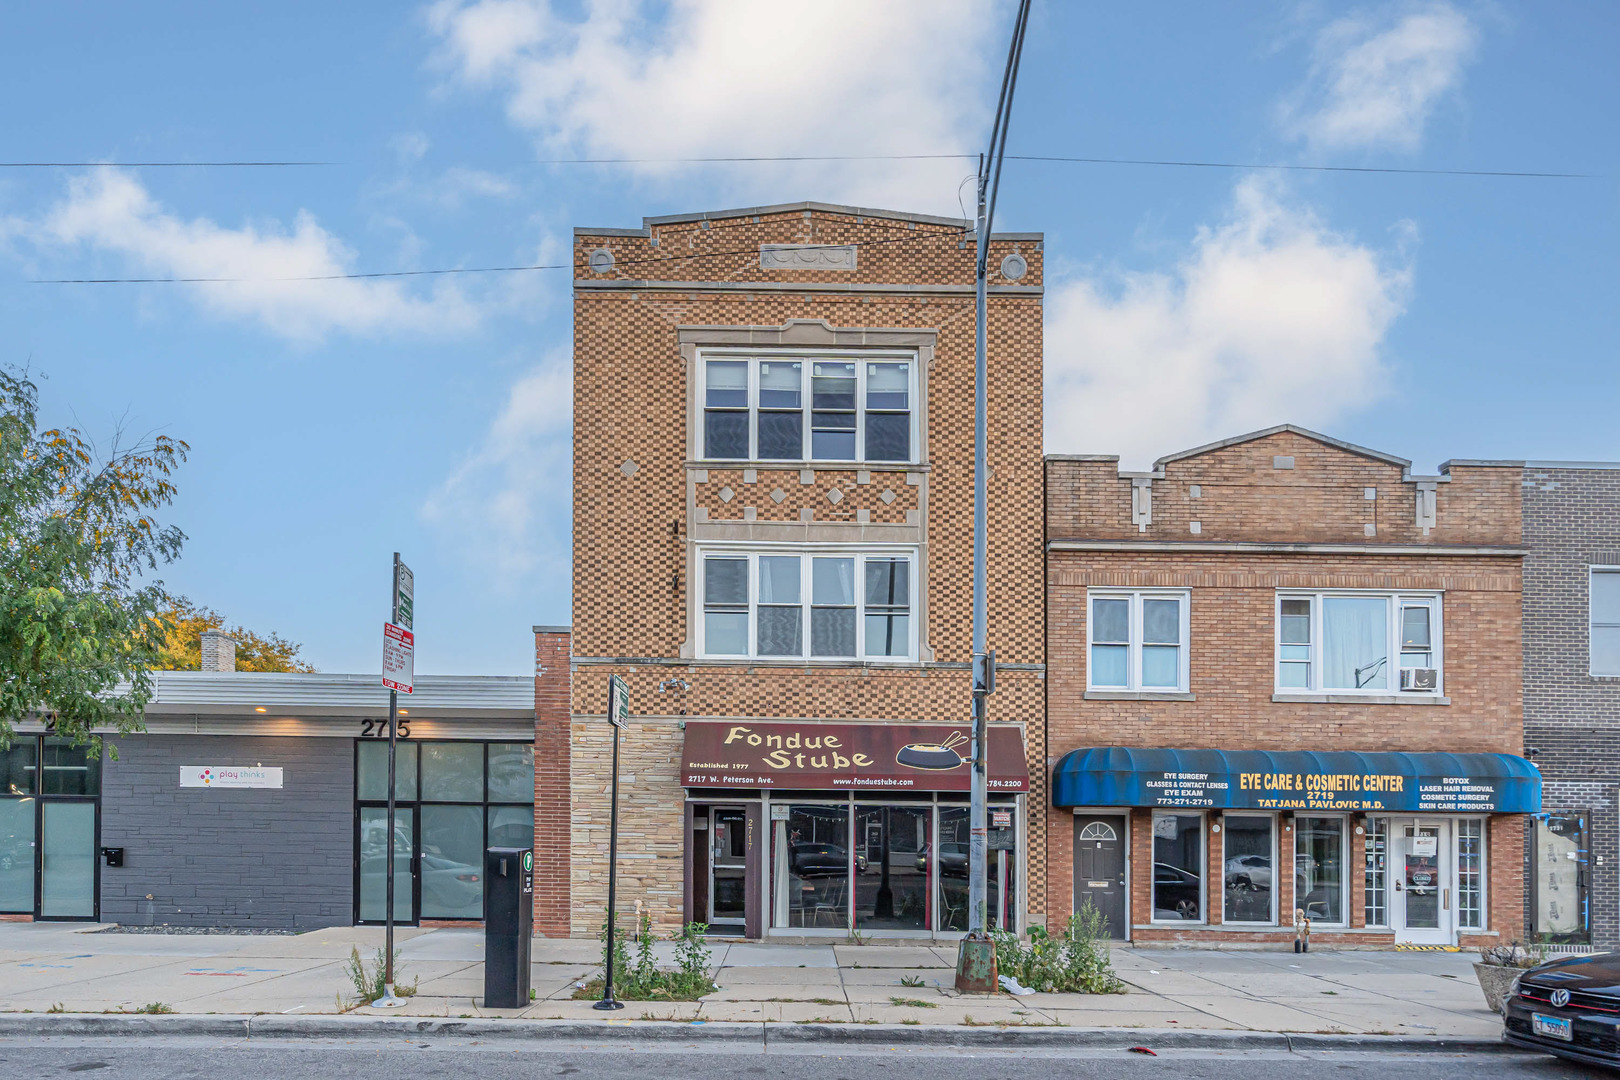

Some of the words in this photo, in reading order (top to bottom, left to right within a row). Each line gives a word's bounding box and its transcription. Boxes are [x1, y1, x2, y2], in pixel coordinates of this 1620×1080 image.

[385, 680, 395, 688] TOW
[397, 683, 410, 693] ZONE
[361, 719, 410, 737] 275
[724, 726, 842, 749] Fondue
[762, 750, 874, 769] Stube
[220, 770, 238, 779] play
[833, 778, 913, 786] www.fonduestube.com
[1240, 773, 1261, 789] EYE
[1264, 774, 1292, 790] CARE
[1295, 774, 1303, 790] &
[1306, 774, 1360, 791] COSMETIC
[1363, 775, 1403, 792] CENTER
[1307, 791, 1334, 800] 2719
